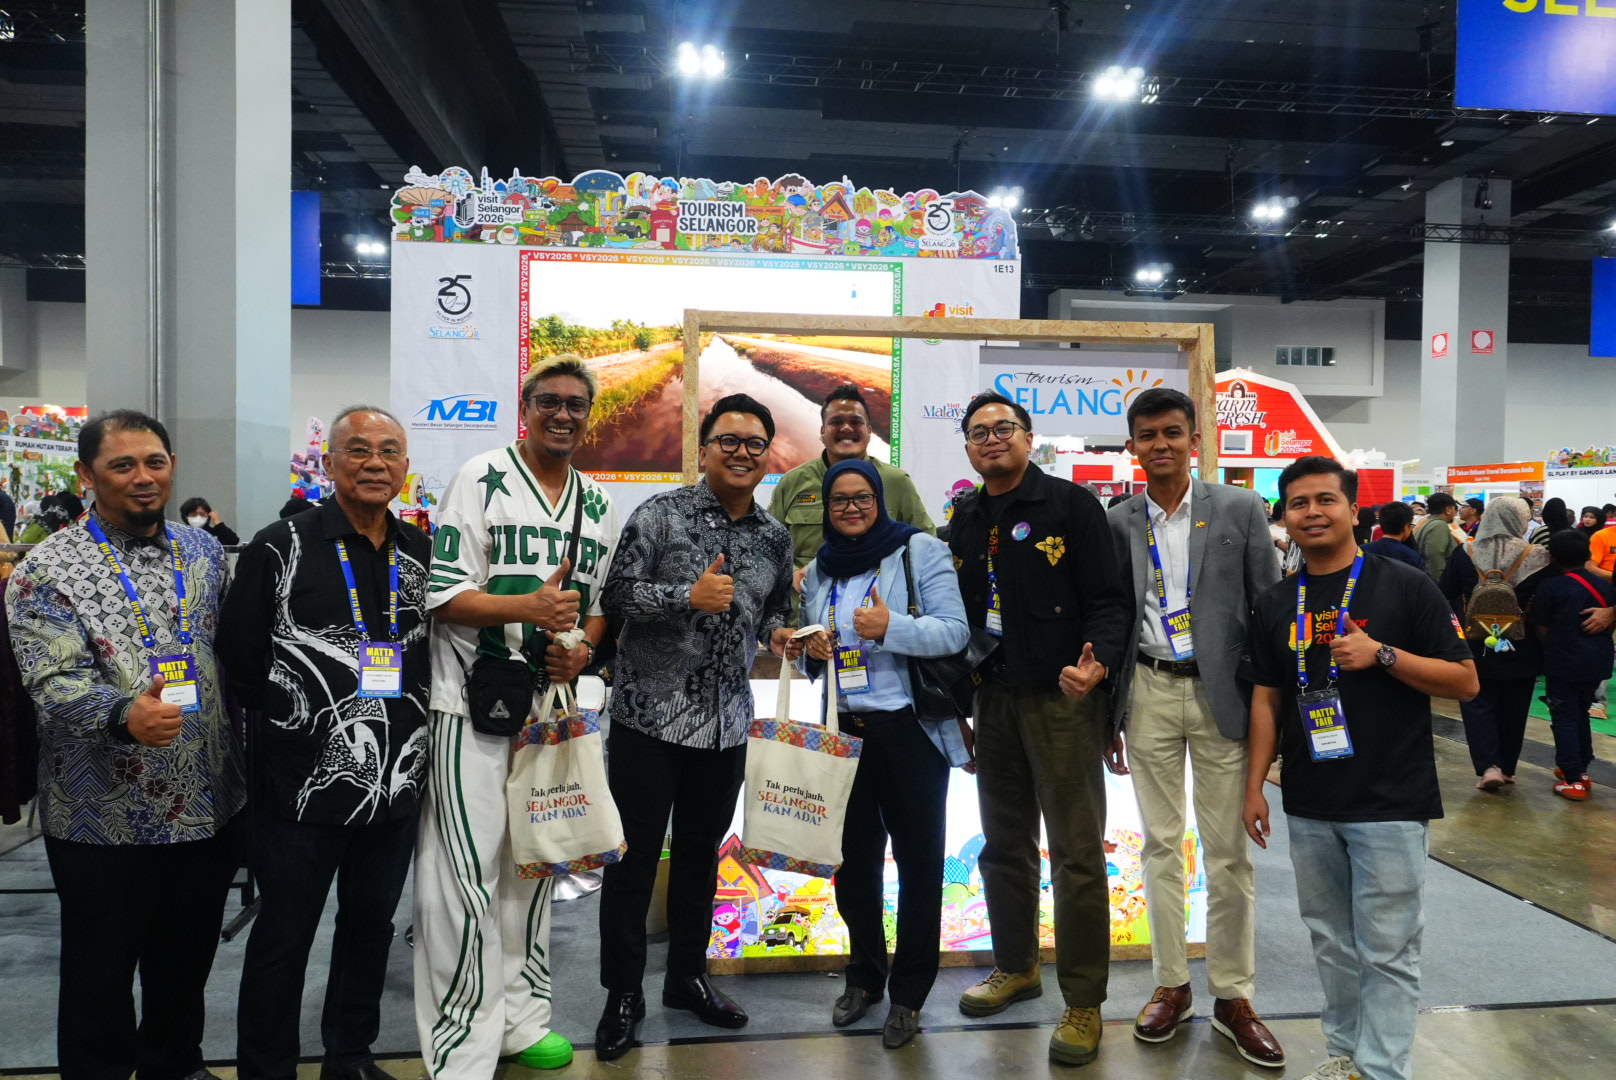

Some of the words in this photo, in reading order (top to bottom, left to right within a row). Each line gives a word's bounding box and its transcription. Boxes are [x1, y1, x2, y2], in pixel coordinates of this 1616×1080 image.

[478, 192, 498, 204] visit
[478, 204, 520, 216] Selangor
[680, 202, 743, 218] TOURISM
[478, 214, 504, 223] 2026
[680, 218, 756, 233] SELANGOR
[533, 252, 572, 260] VSY2026
[580, 253, 618, 262] VSY2026
[626, 256, 664, 264] VSY2026
[672, 257, 710, 266] VSY2026
[717, 258, 755, 266] VSY2026
[762, 260, 800, 268] VSY2026
[807, 262, 844, 270] VSY2026
[852, 262, 888, 270] VSY2026
[994, 264, 1014, 274] 1E13
[949, 302, 974, 316] visit
[430, 326, 479, 338] SELANGOR
[994, 373, 1144, 416] SELANG
[427, 400, 498, 422] MBI
[366, 647, 394, 656] MATTA
[840, 650, 861, 660] MATTA
[371, 656, 390, 664] FAIR
[844, 658, 858, 666] FAIR
[158, 661, 188, 672] MATTA
[164, 671, 185, 681] FAIR
[1309, 707, 1336, 719] MATTA
[1315, 717, 1334, 727] FAIR
[530, 787, 546, 797] Tak
[766, 780, 781, 790] Tak
[783, 785, 804, 796] perlu
[526, 794, 592, 812] SELANGOR
[757, 790, 830, 819] SELANGOR
[530, 810, 558, 824] KAN
[561, 806, 587, 819] ADA!
[763, 803, 791, 816] KAN
[794, 811, 821, 826] ADA!
